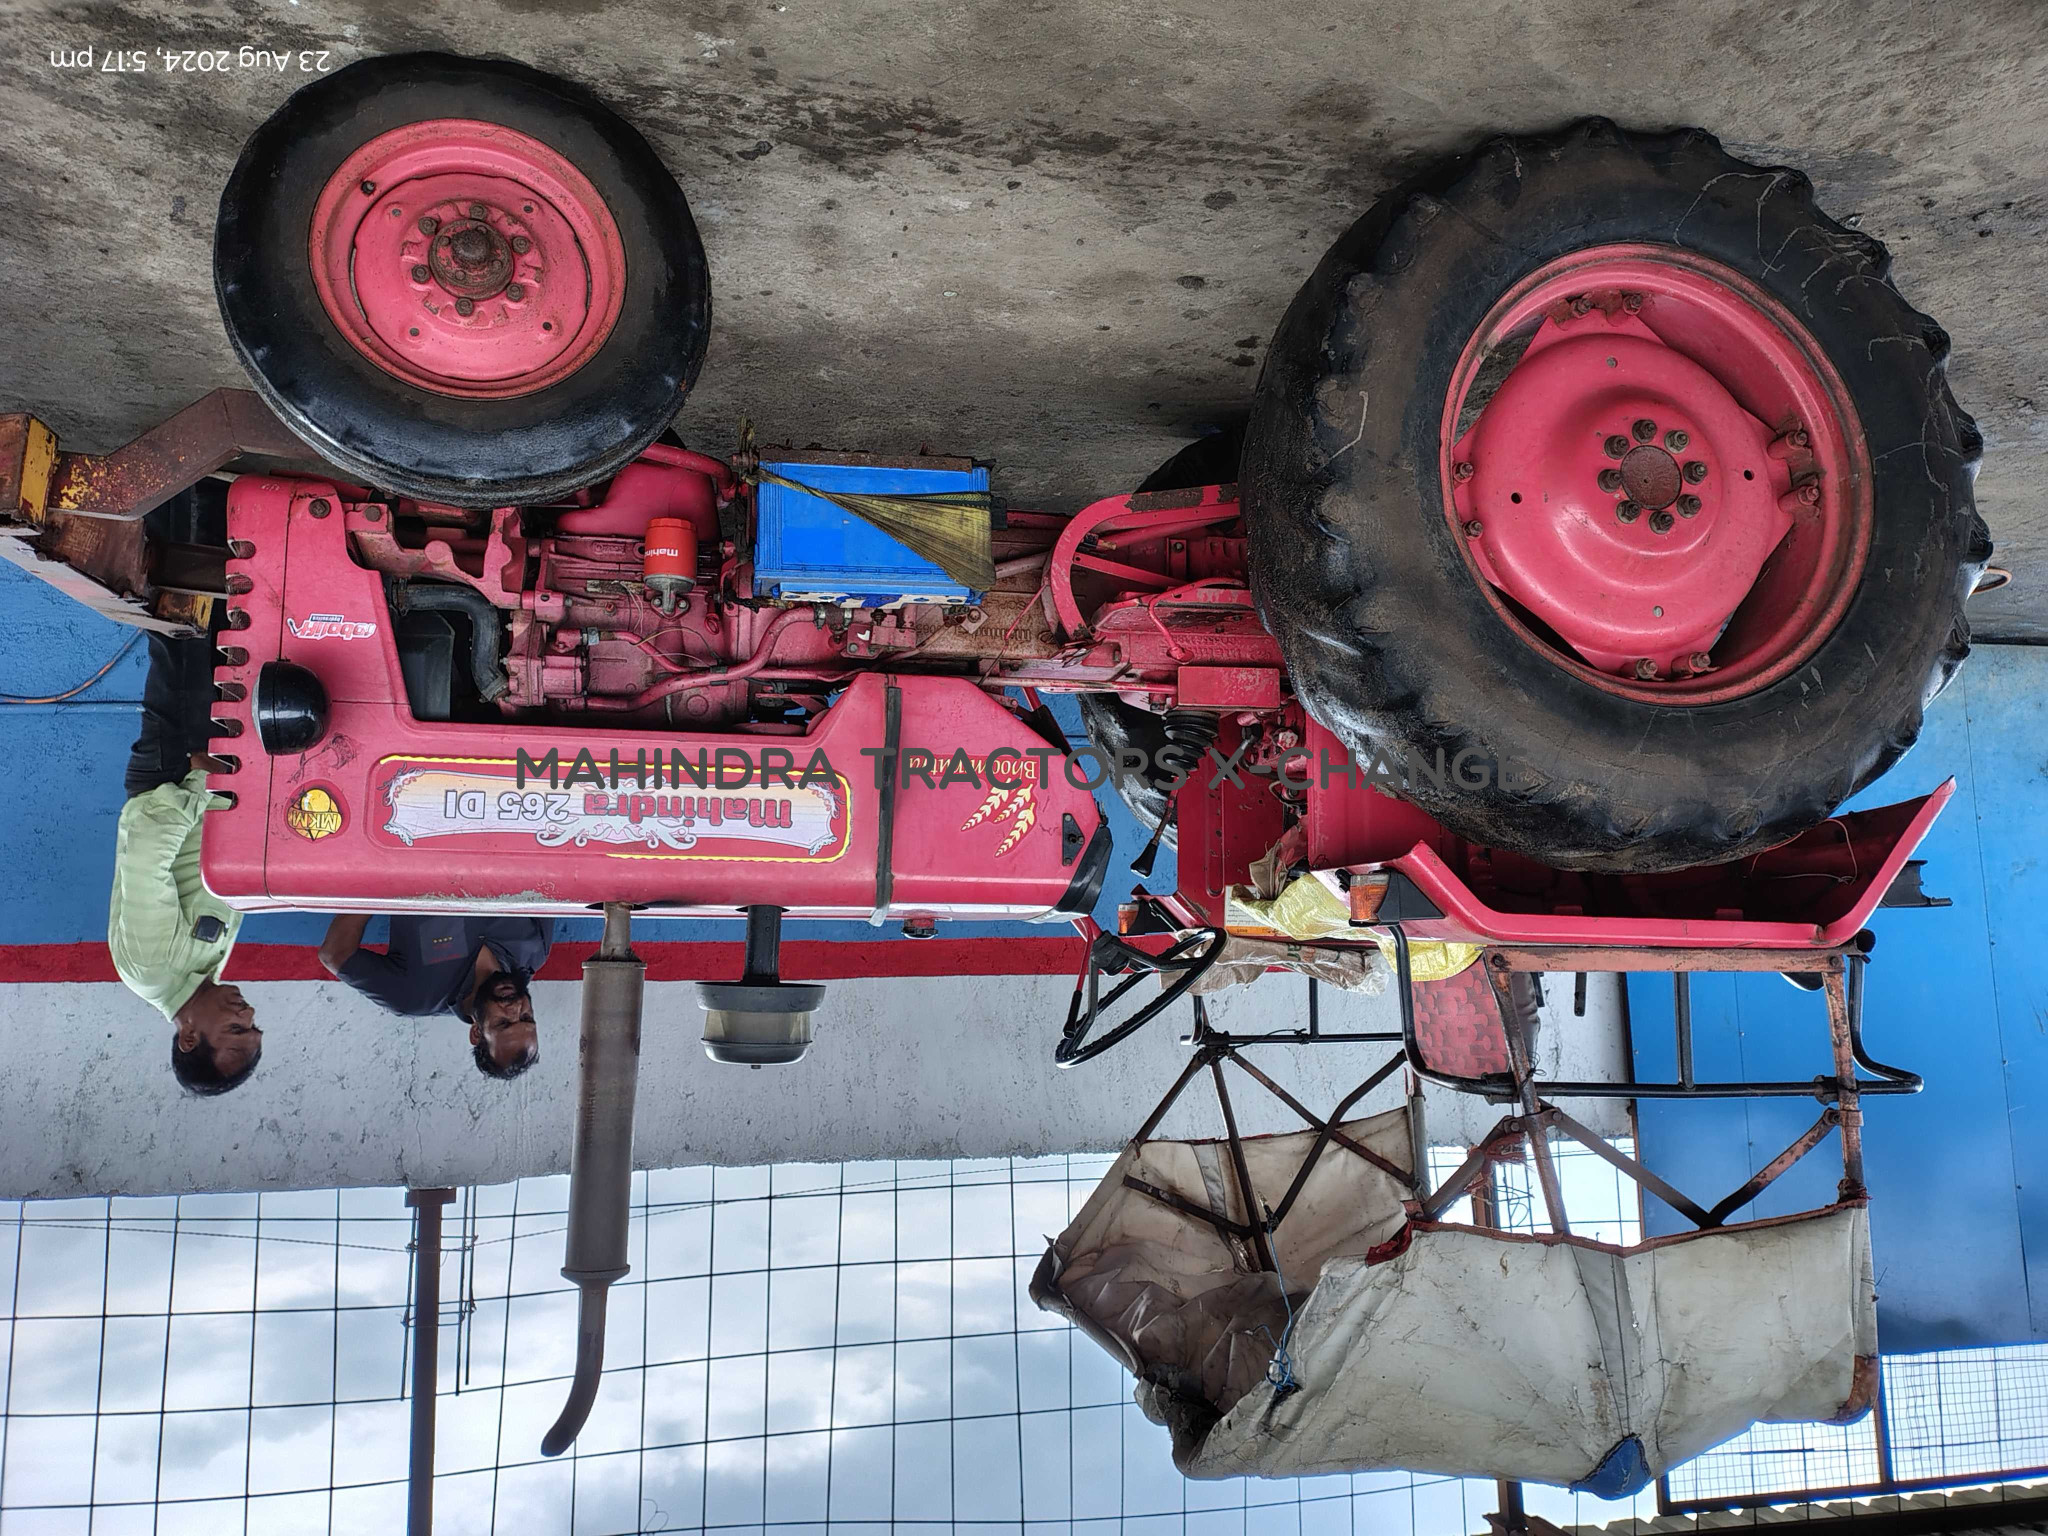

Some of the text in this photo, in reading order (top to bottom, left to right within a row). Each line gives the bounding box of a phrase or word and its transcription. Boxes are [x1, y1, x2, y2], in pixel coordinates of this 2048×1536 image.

[292, 811, 338, 831] MKM
[444, 790, 792, 828] Mahindra 265 DI
